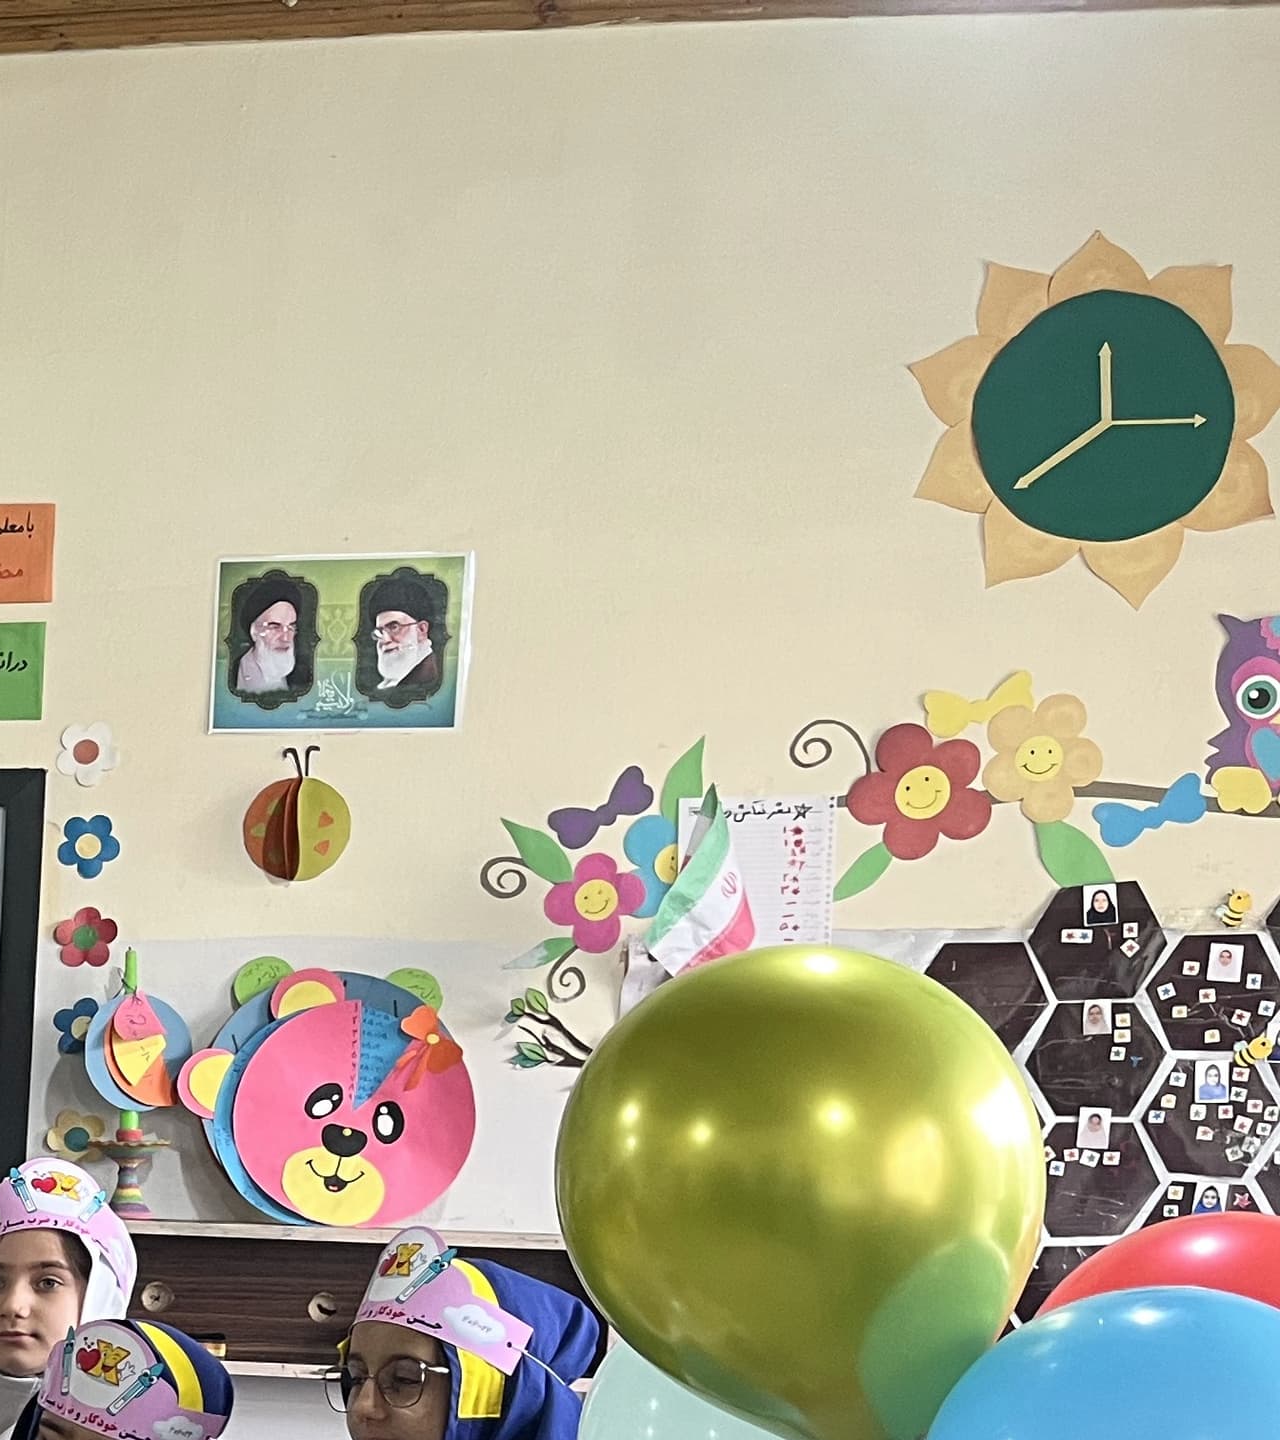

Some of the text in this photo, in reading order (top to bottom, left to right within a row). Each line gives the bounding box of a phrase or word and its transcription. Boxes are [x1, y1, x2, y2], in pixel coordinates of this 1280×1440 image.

[25, 511, 34, 537] با
[15, 652, 28, 671] در
[373, 1305, 406, 1320] خودکار
[406, 1313, 443, 1334] جشن
[82, 1413, 117, 1432] خودکار
